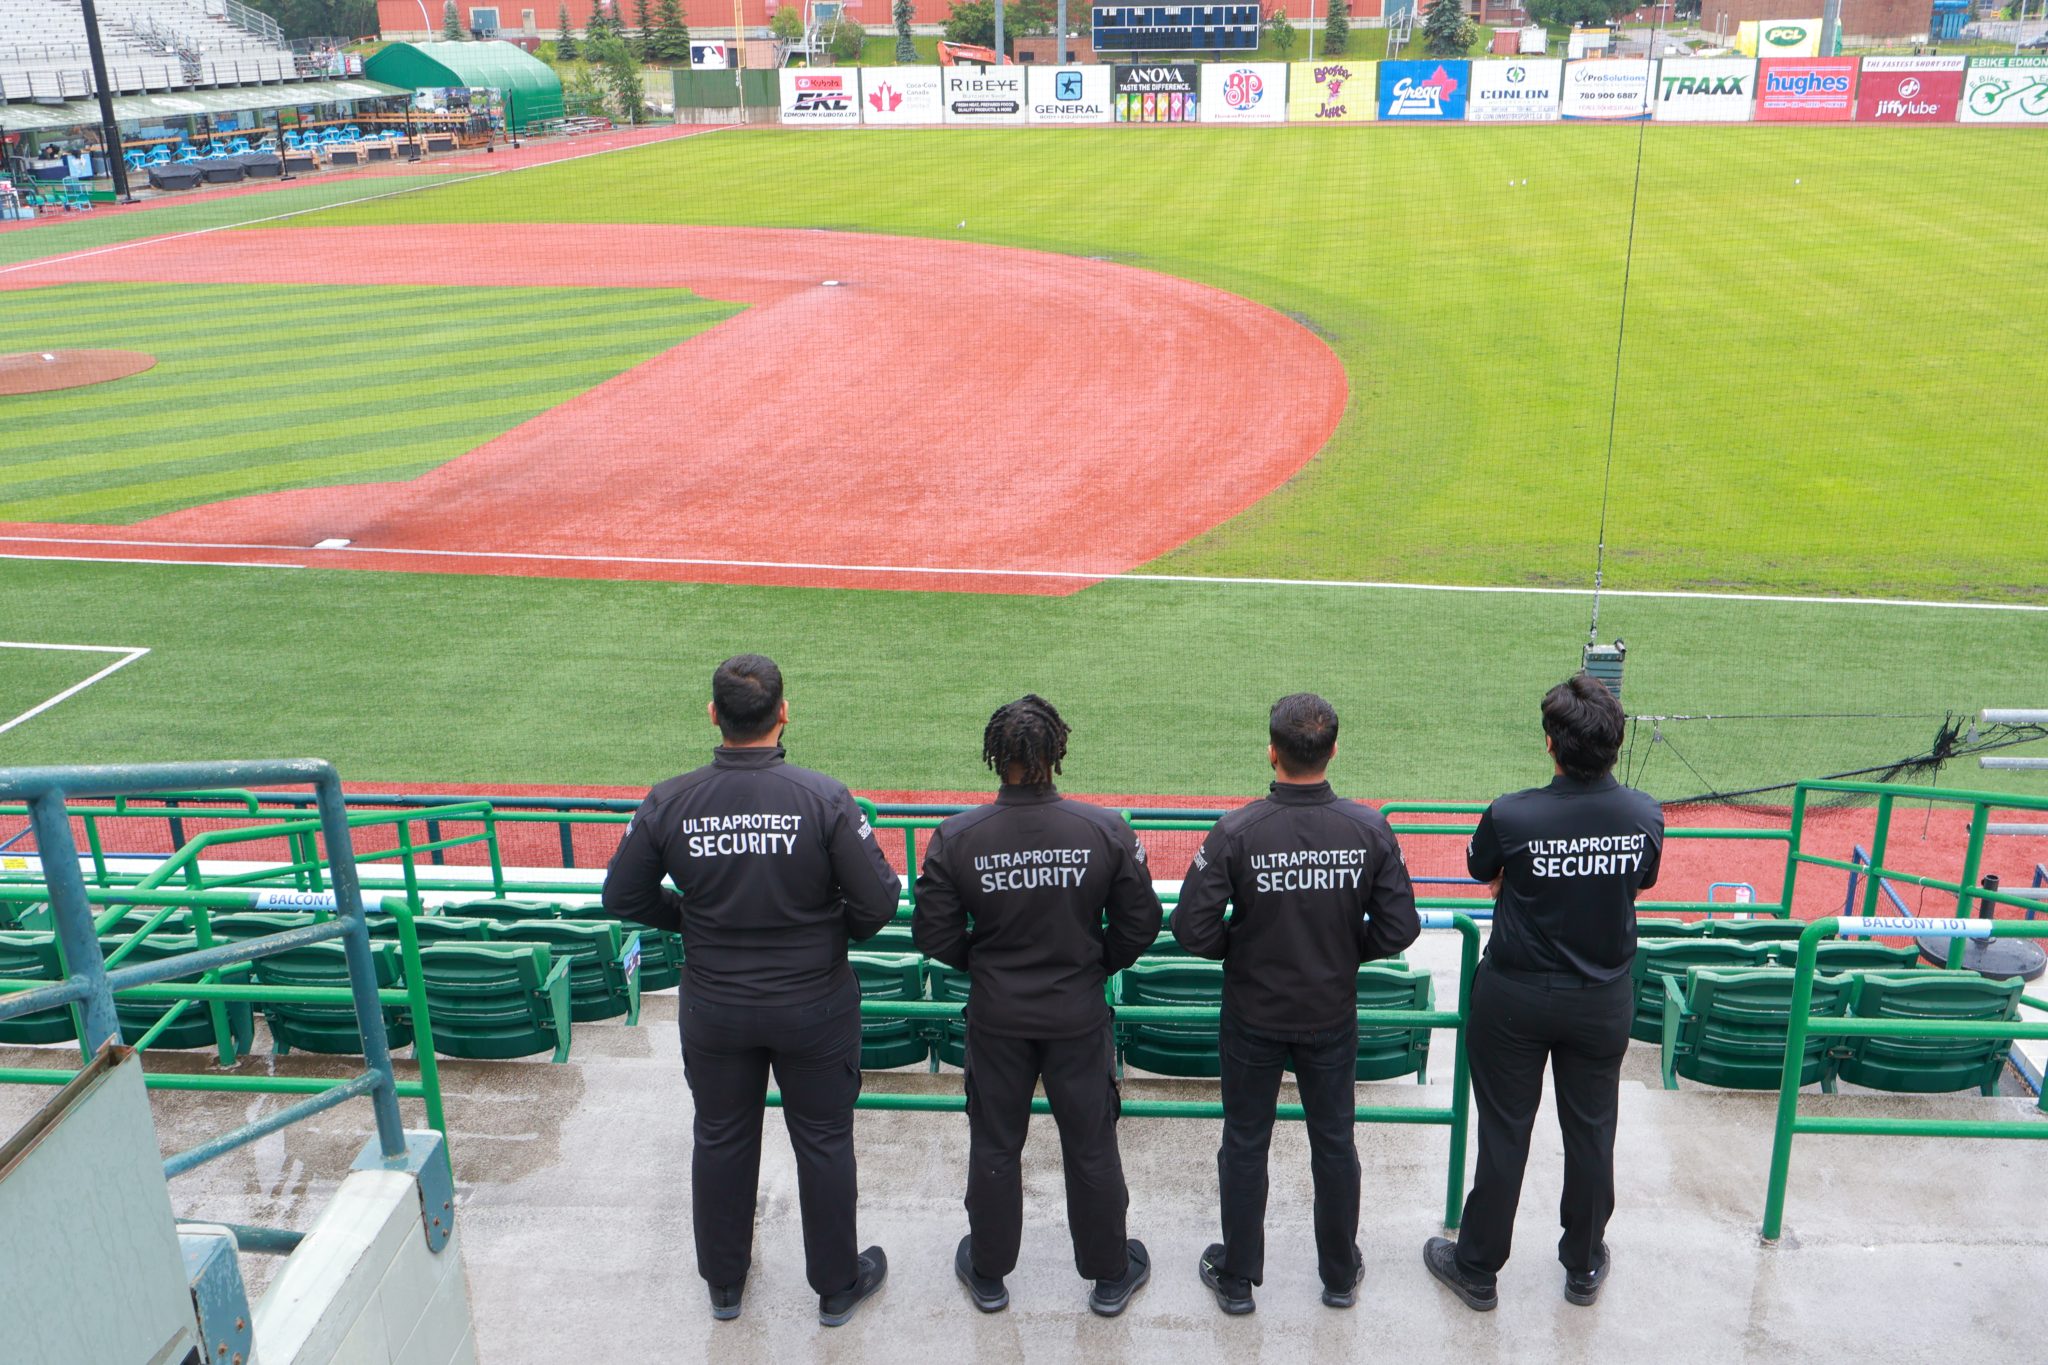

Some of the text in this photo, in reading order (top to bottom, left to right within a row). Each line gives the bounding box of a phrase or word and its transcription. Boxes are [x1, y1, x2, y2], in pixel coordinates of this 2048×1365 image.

[1769, 29, 1803, 41] PCL
[1971, 57, 2006, 68] EBIKE
[950, 78, 1019, 91] RIBEYE
[1127, 67, 1183, 83] ANOVA
[1766, 71, 1849, 96] hughes
[1120, 84, 1138, 92] TASTE
[1152, 83, 1191, 91] DIFFERENCE.
[1480, 90, 1549, 99] CONLON
[1662, 75, 1750, 101] TRAXX
[794, 92, 848, 110] EKL
[1034, 104, 1104, 114] GENERAL
[682, 814, 802, 835] ULTRAPROTECT
[688, 832, 797, 858] SECURITY
[1528, 834, 1647, 854] ULTRAPROTECT
[974, 849, 1091, 872] ULTRAPROTECT
[1250, 849, 1367, 870] ULTRAPROTECT
[1532, 851, 1643, 878] SECURITY
[980, 867, 1086, 893] SECURITY
[1256, 868, 1362, 893] SECURITY
[269, 894, 333, 906] BALCONY
[1862, 917, 1966, 930] BALCONY 101
